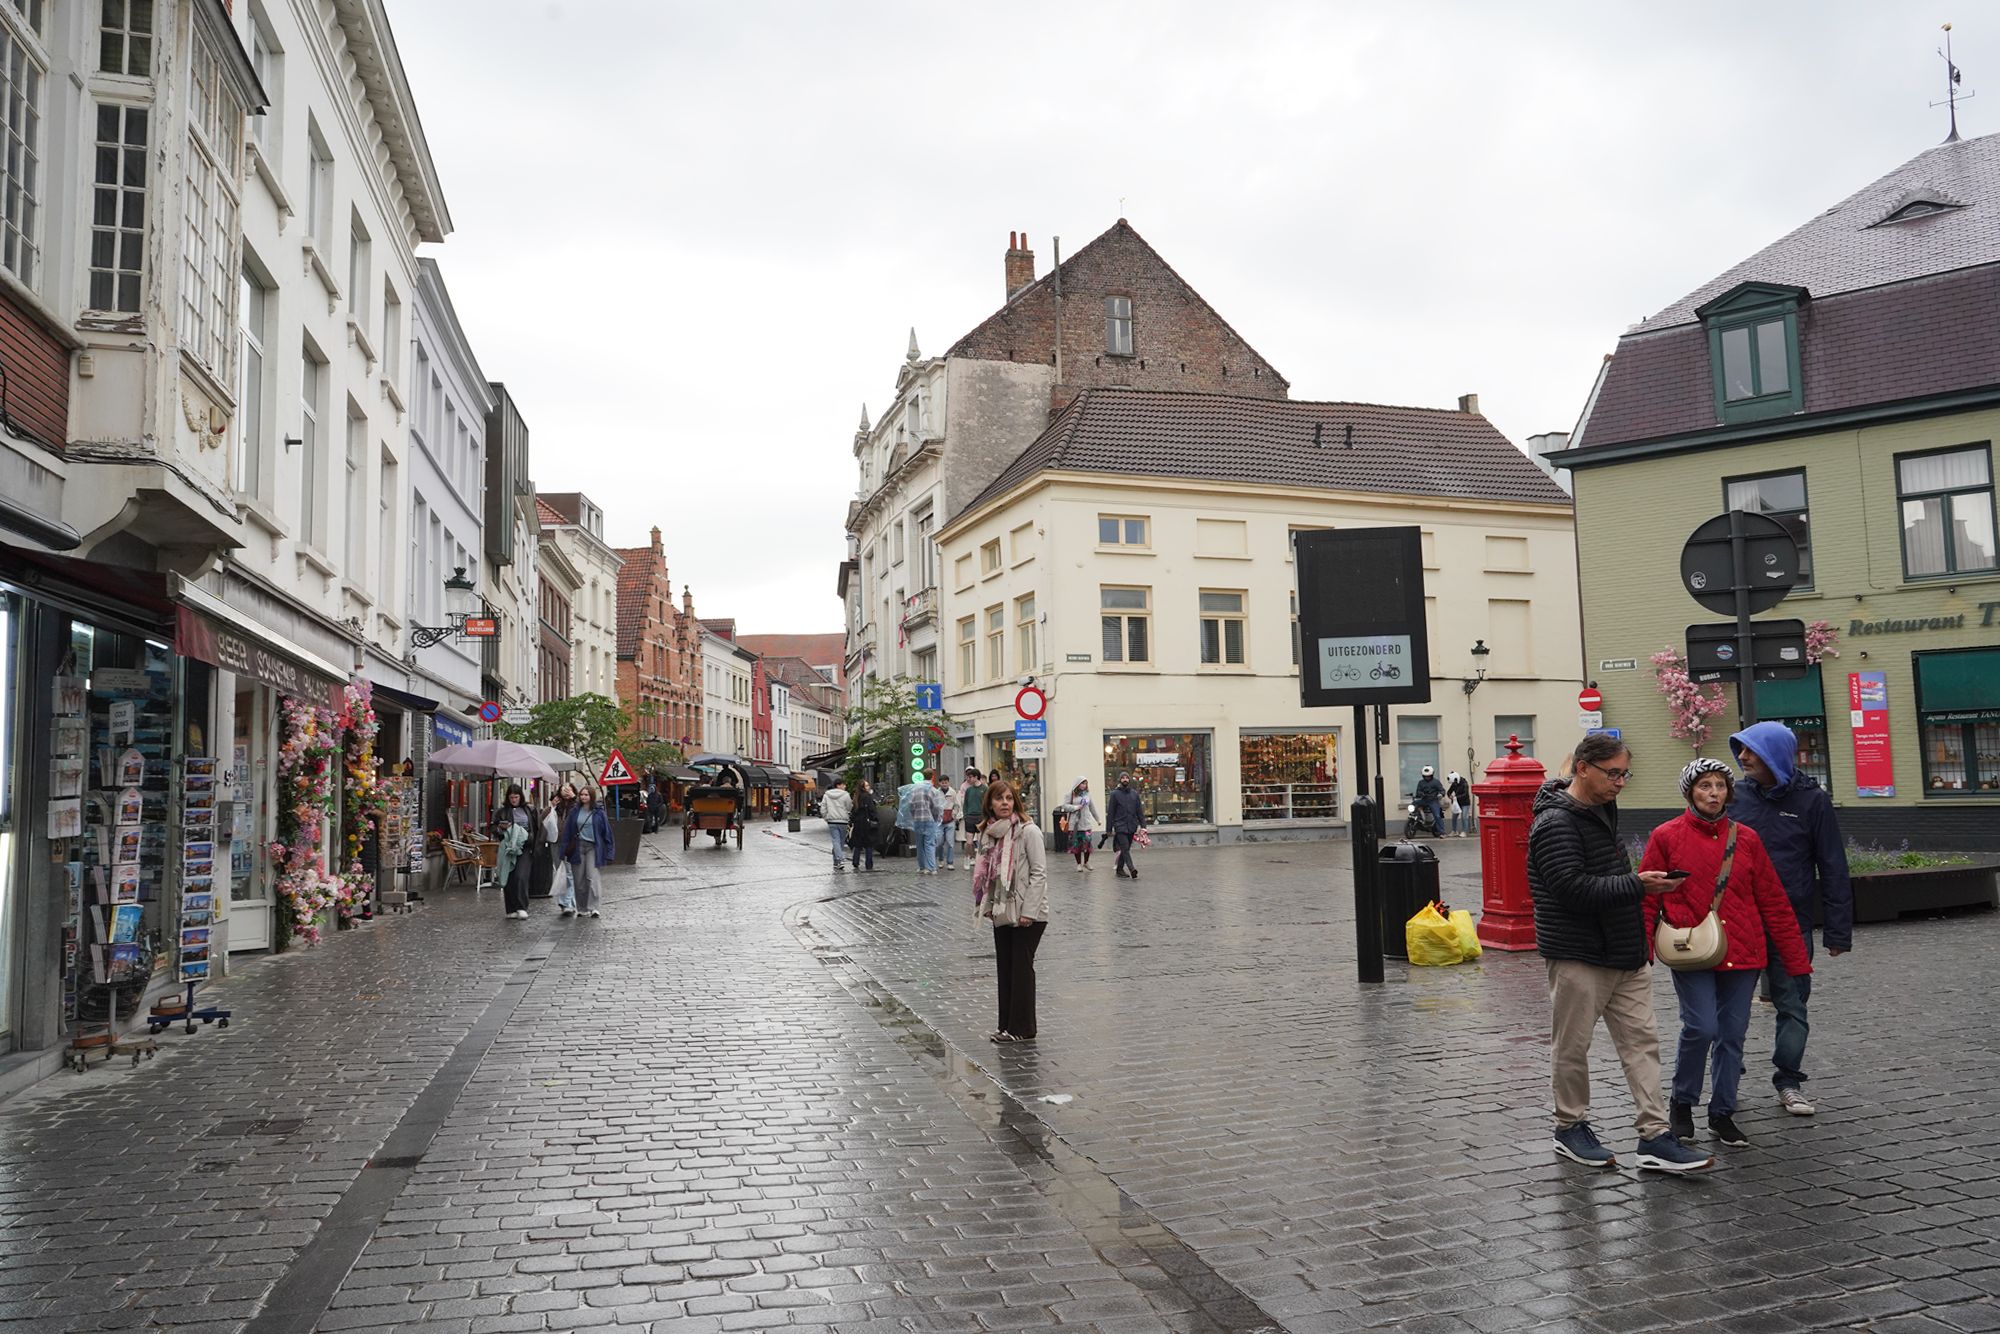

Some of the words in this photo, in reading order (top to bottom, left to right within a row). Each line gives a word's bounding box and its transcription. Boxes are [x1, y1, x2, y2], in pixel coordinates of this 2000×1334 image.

[1848, 613, 1965, 637] Restaurant
[1977, 601, 2000, 627] T
[217, 634, 249, 671] BEER
[256, 650, 299, 692] SOUVENIR
[1327, 644, 1401, 657] UITGEZONDERD
